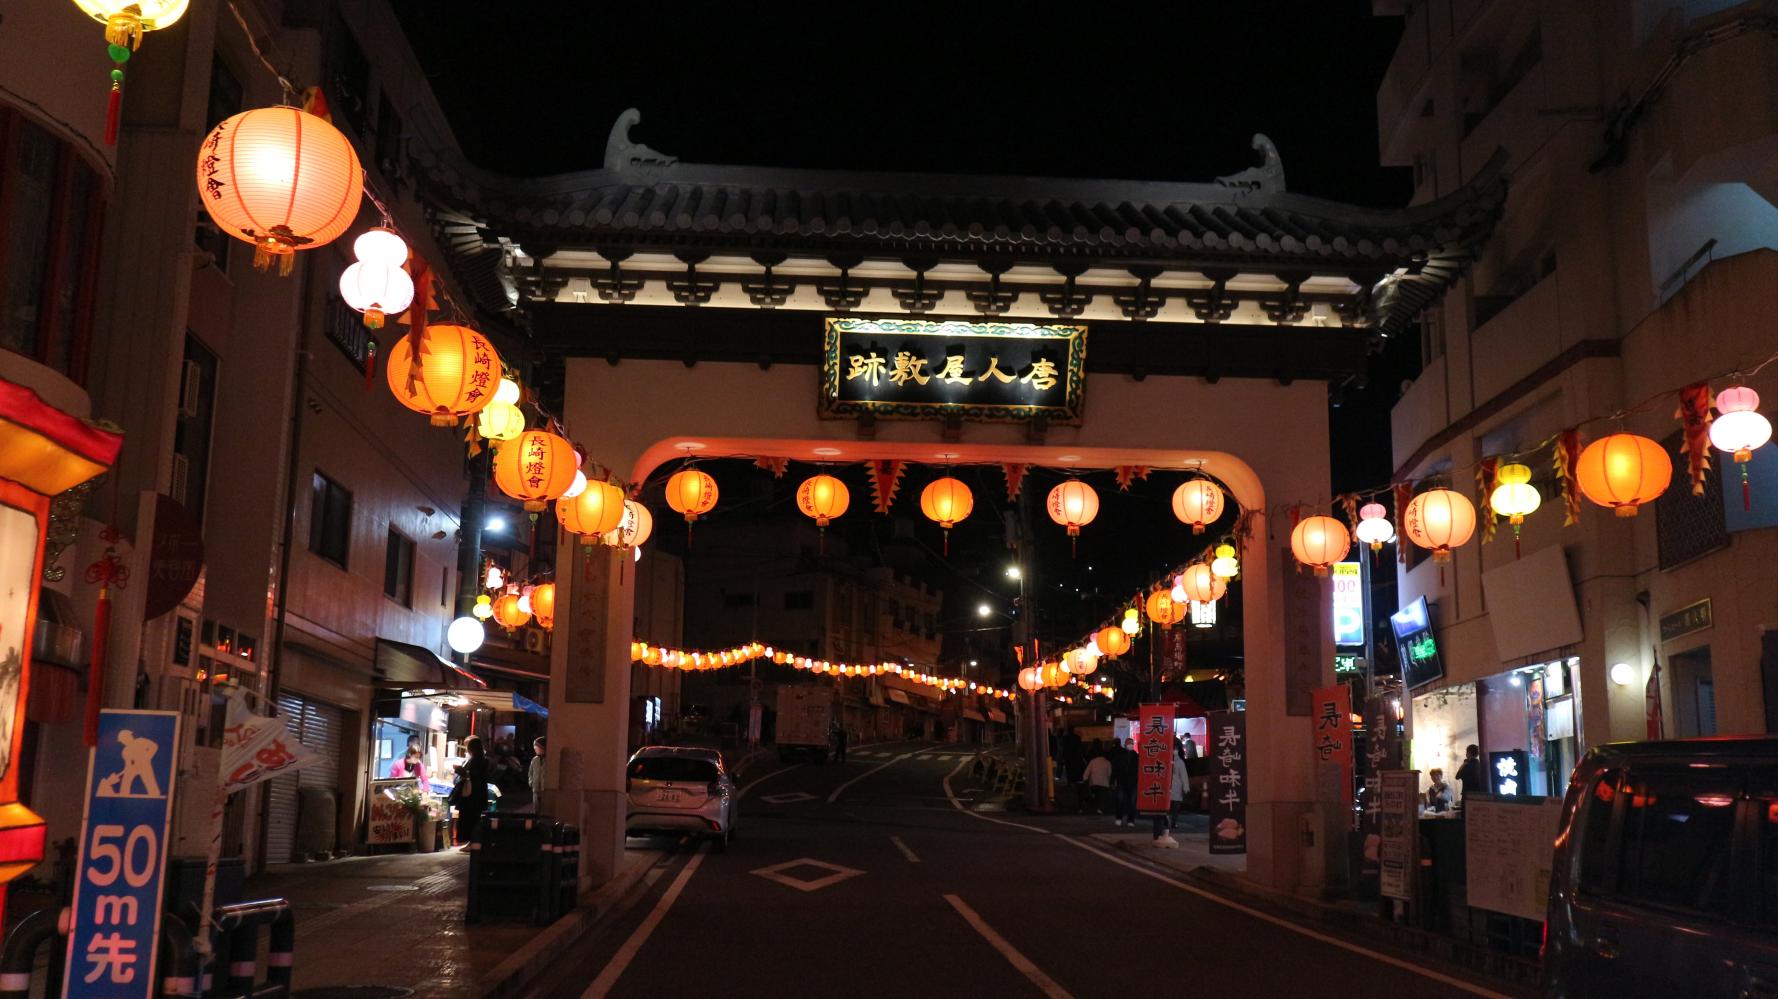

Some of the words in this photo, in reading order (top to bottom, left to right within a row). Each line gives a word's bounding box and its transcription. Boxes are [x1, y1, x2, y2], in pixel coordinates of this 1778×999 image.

[465, 335, 492, 403] 長崎燈會
[846, 351, 1059, 391] 唐人屋敷跡
[526, 436, 547, 488] 長崎燈會
